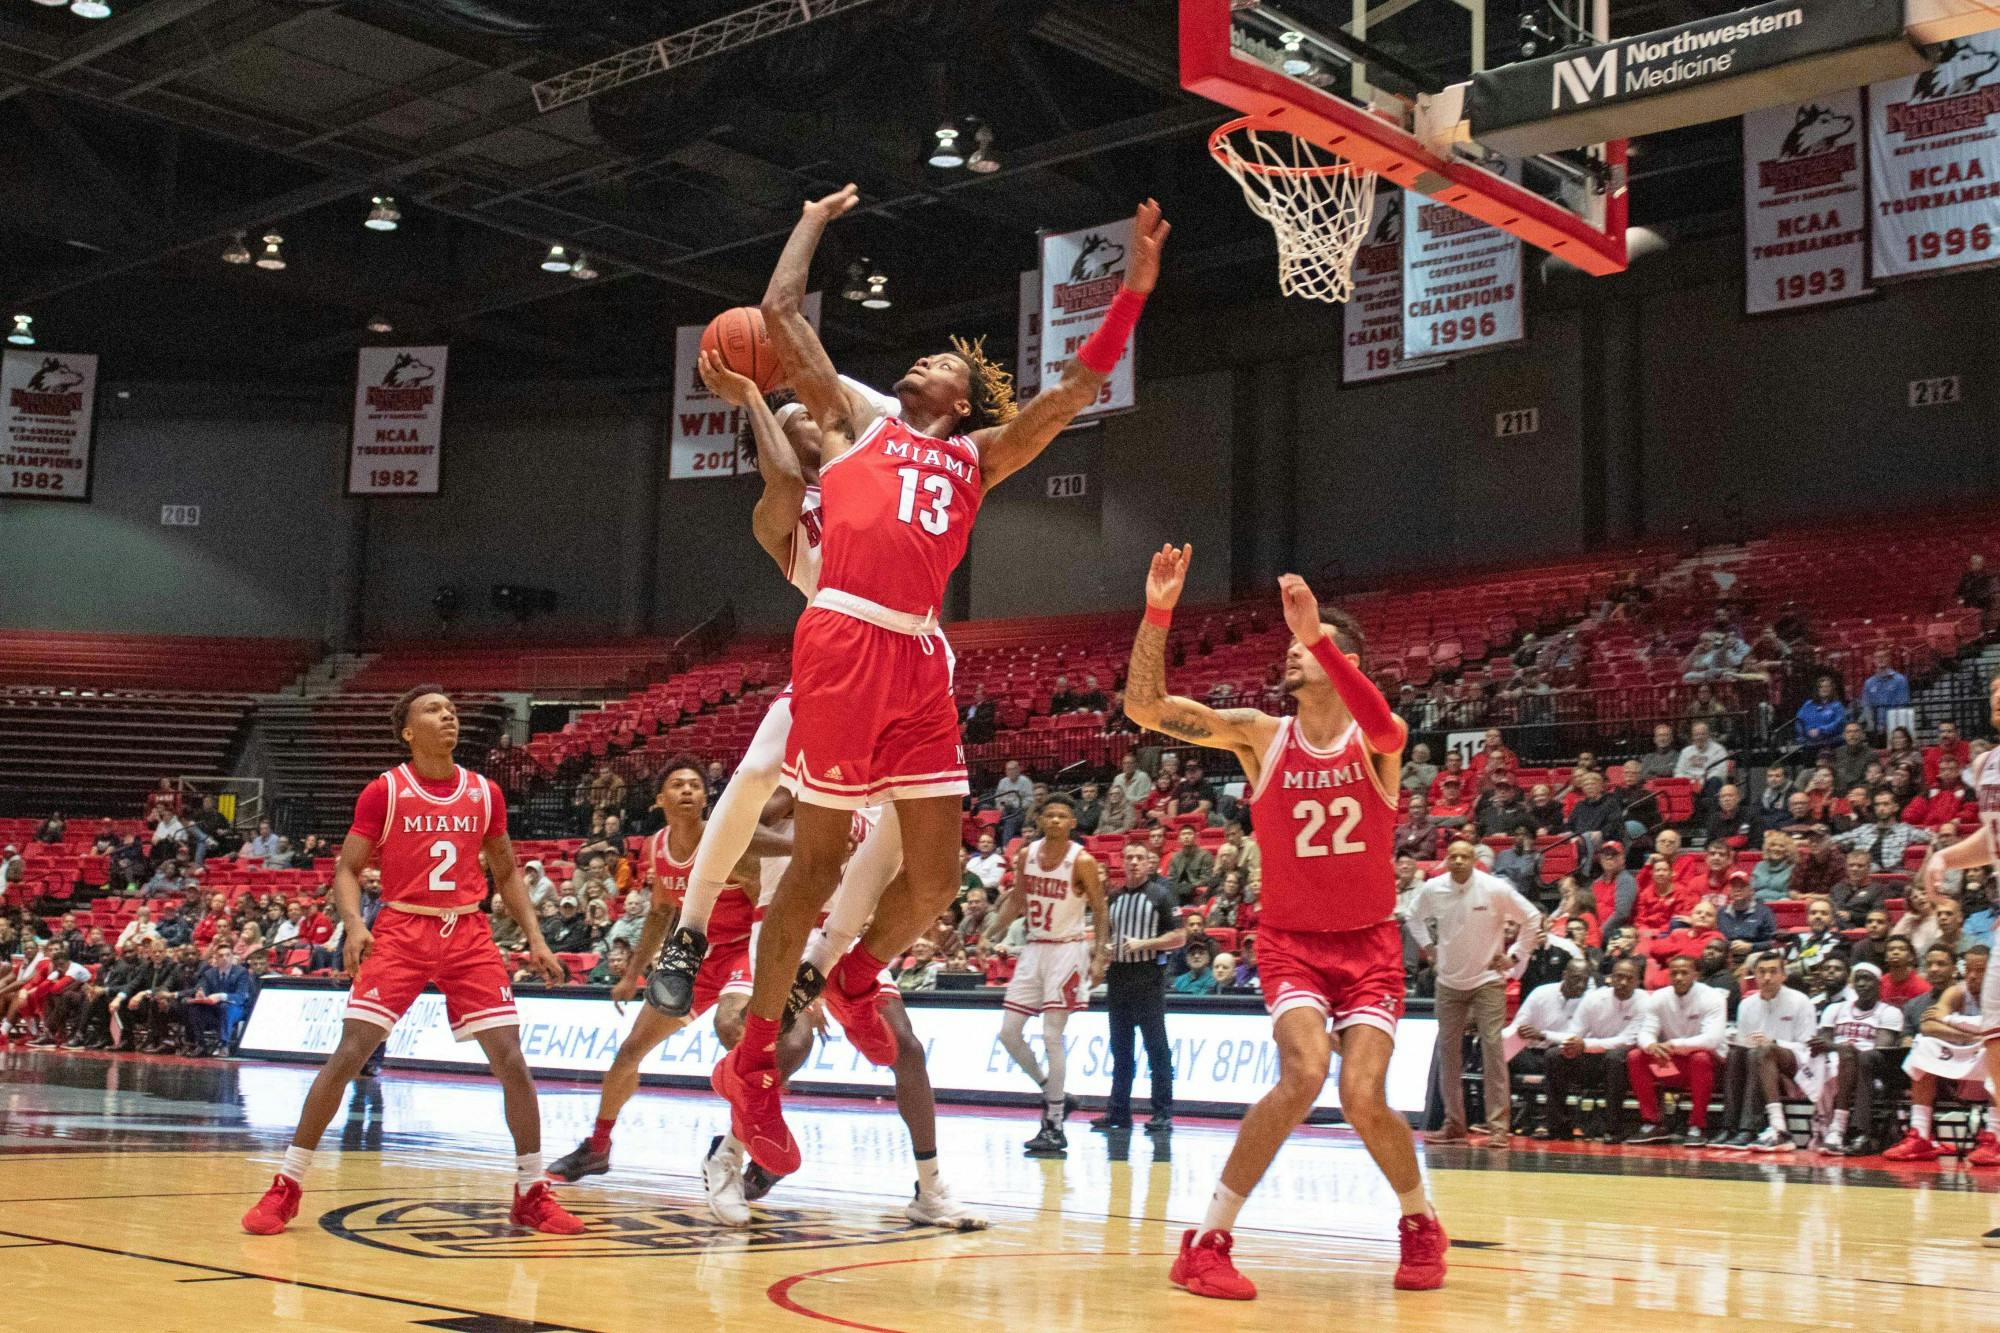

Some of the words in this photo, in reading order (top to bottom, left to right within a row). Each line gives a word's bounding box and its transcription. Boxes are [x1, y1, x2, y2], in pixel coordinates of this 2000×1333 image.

[1626, 9, 1803, 66] Northwestern
[1625, 54, 1733, 93] Medicine
[1909, 158, 1984, 191] NCAA
[1879, 181, 2000, 216] TOURNAMEN
[1776, 209, 1840, 238] NCAA
[1906, 222, 1991, 262] 1996
[1408, 283, 1514, 317] CHAMPIONS
[1775, 267, 1846, 302] 1993
[1430, 312, 1497, 346] 1996
[376, 428, 418, 442] NCAA
[680, 410, 739, 436] WNI
[1502, 411, 1532, 434] 211
[370, 470, 418, 487] 1982
[884, 439, 977, 485] MIAMI
[12, 471, 64, 490] 1982
[1052, 476, 1082, 496] 210
[897, 466, 954, 537] 13
[1281, 761, 1366, 789] MIAMI
[403, 815, 479, 833] MIAMI
[1292, 796, 1367, 858] 22
[428, 840, 458, 892] 2
